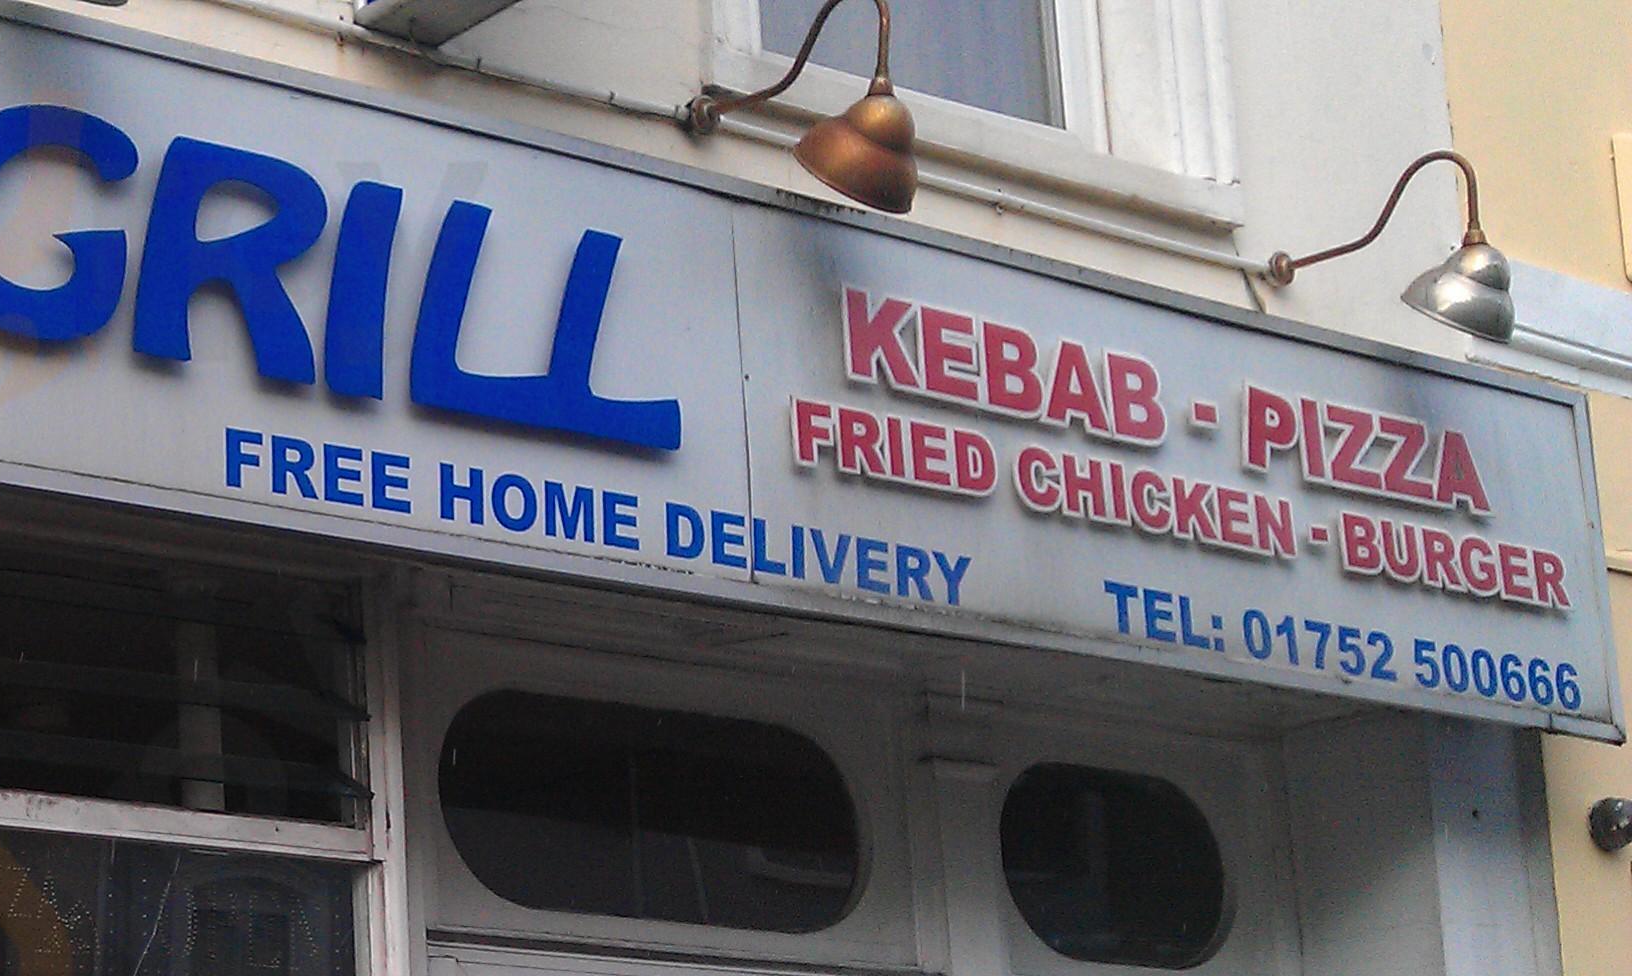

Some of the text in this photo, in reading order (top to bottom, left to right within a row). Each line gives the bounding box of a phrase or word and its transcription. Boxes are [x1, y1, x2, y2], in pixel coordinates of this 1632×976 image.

[843, 284, 1166, 447] KEBAB
[1243, 383, 1492, 516] PIZZA
[225, 426, 971, 606] FREE HOME DELIVERY
[792, 397, 998, 496] FRIED
[1015, 446, 1298, 560] CHICKEN
[1338, 512, 1571, 610] BURGER
[1103, 580, 1583, 712] TEL: 01752 500666
